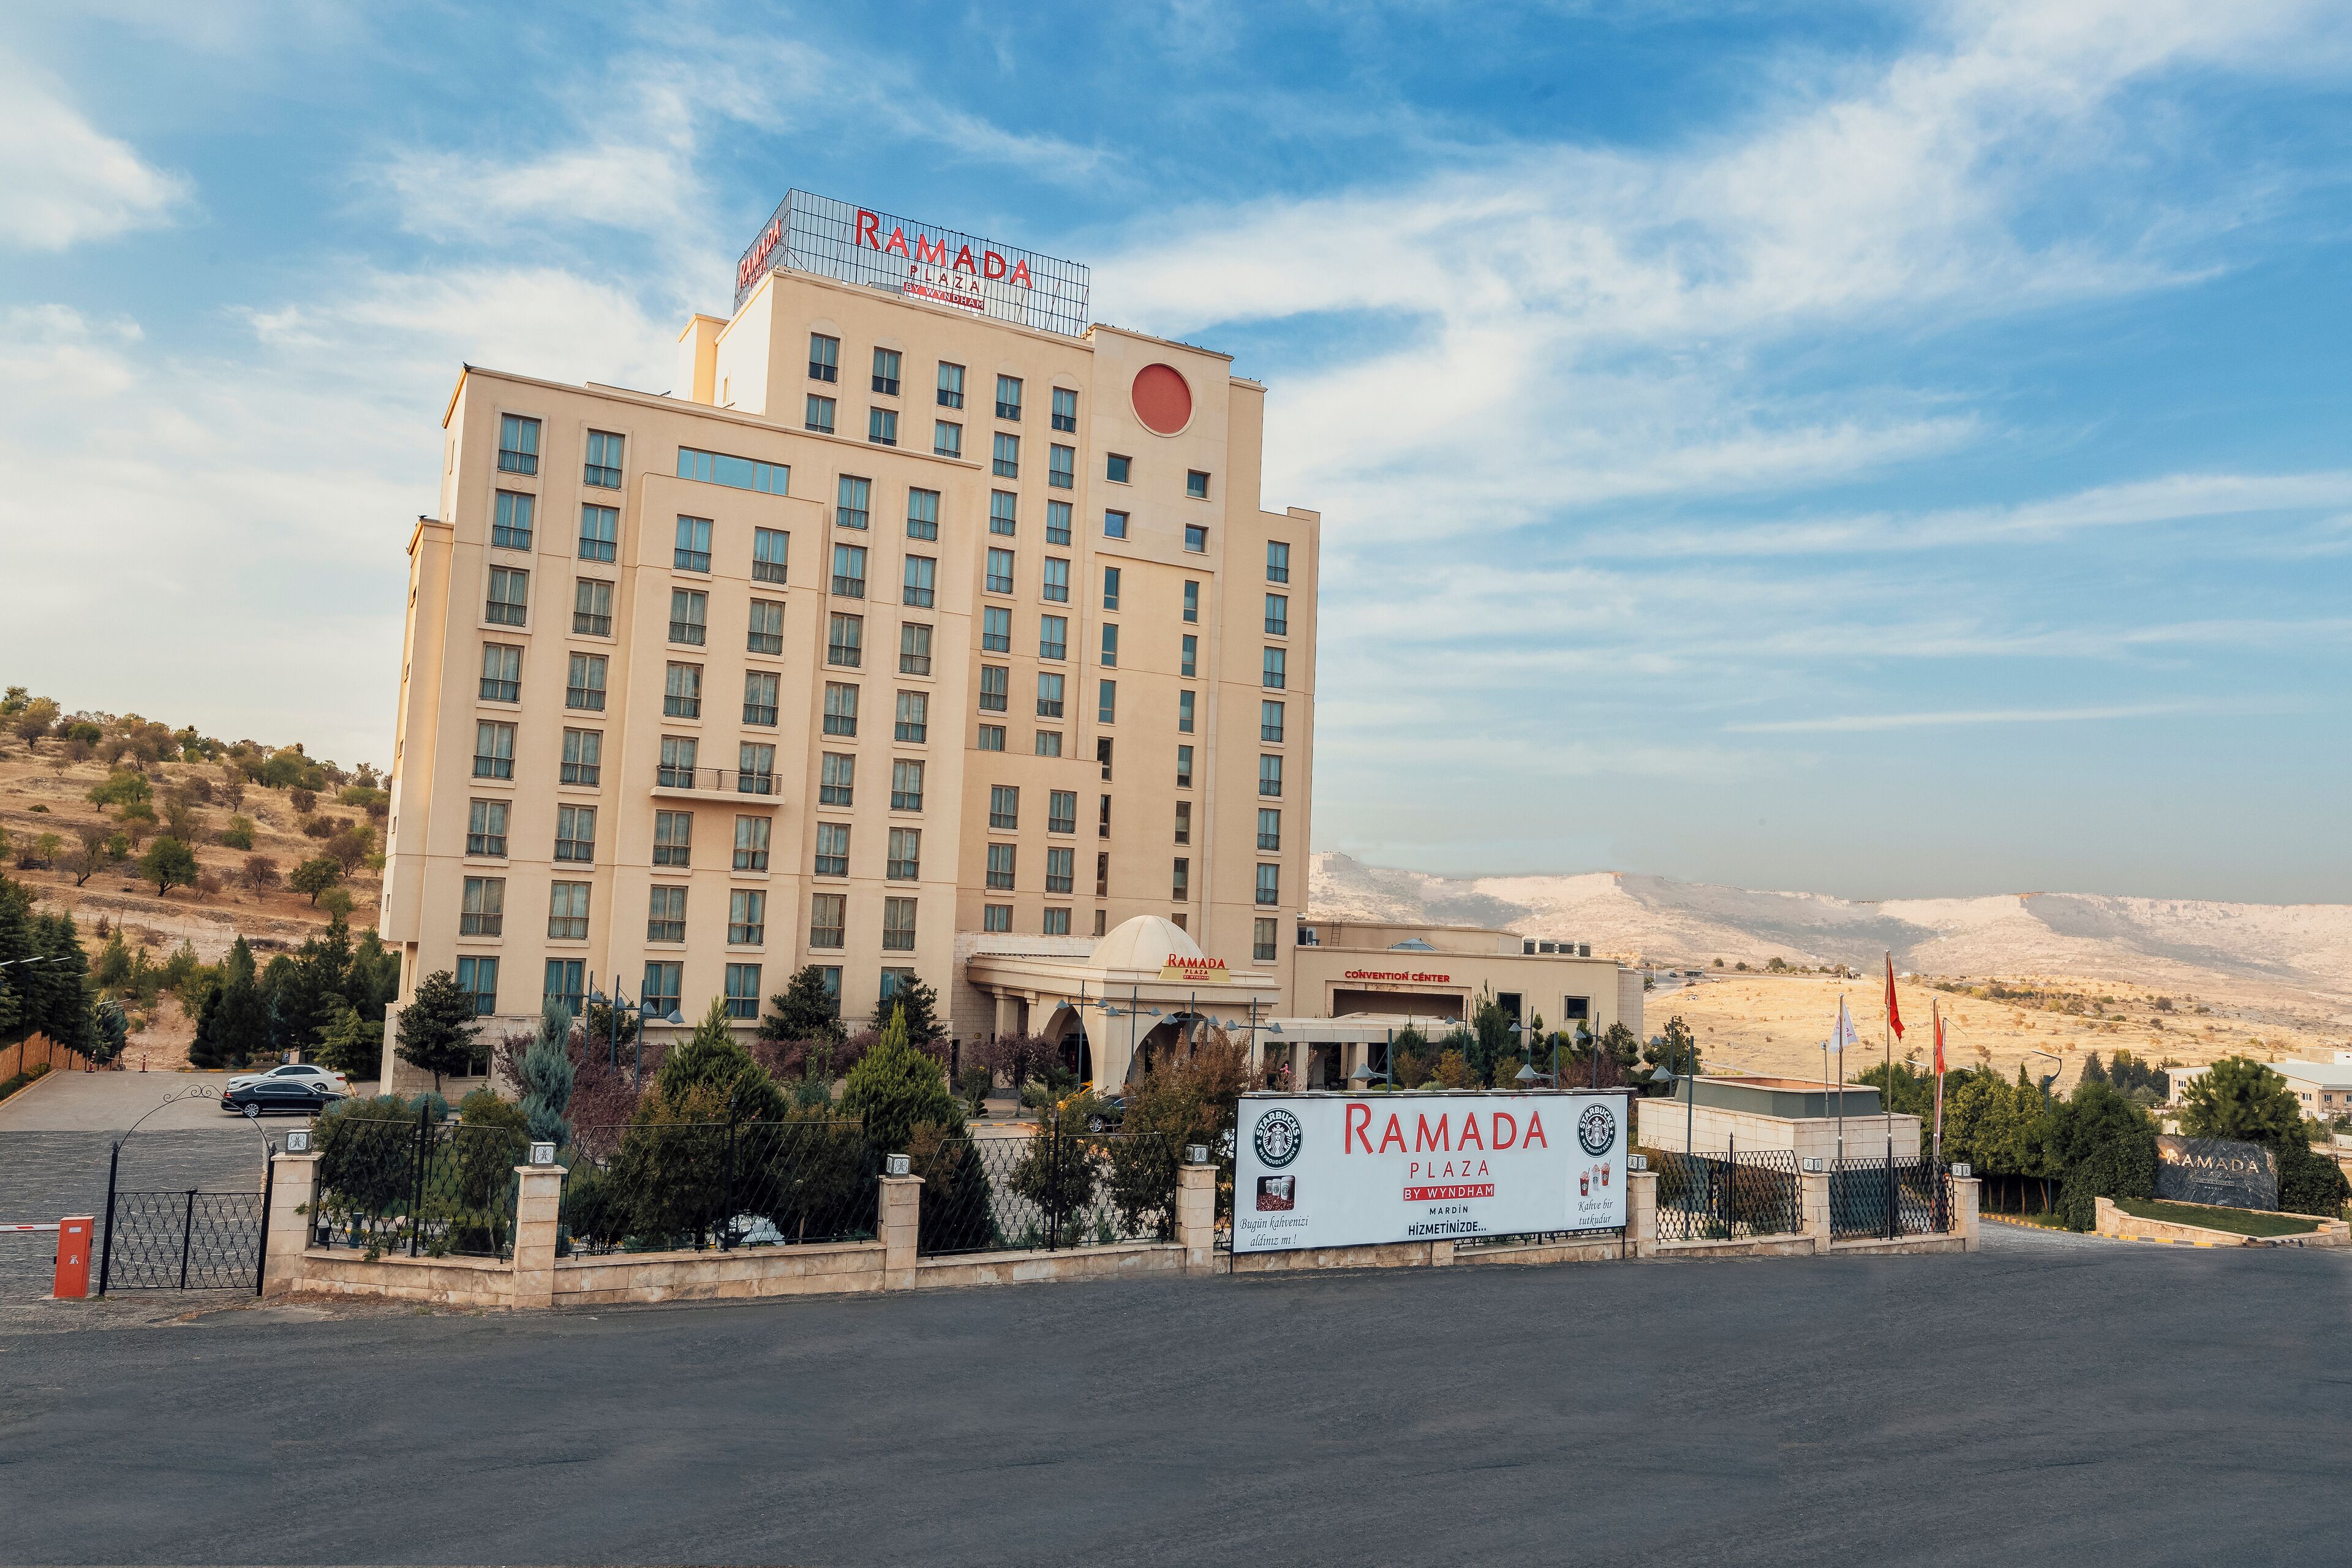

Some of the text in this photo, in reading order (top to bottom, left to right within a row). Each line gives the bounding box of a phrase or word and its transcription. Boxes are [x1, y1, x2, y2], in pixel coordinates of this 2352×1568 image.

[739, 219, 781, 289] RAMADA
[856, 209, 1033, 288] RAMADA
[910, 265, 979, 293] PLAZA
[906, 284, 984, 309] BY WYNDHAM
[1167, 953, 1226, 969] RAMADA
[1344, 970, 1450, 982] CONVENTION CENTER
[1256, 1111, 1300, 1137] STARBUCKS
[1580, 1106, 1614, 1129] STARBUCKS
[1344, 1102, 1548, 1155] RAMADA
[1602, 1137, 1612, 1150] SERVE
[1259, 1147, 1297, 1164] WE PROUDLY SERVE
[2166, 1148, 2260, 1174] RAMADA
[1410, 1159, 1489, 1179] PLAZA
[2195, 1169, 2231, 1180] PLAZA
[1404, 1185, 1493, 1199] BY WYNDHAM
[1430, 1204, 1468, 1215] MARDİN
[1578, 1198, 1613, 1213] Kahve bir
[1239, 1215, 1309, 1232] Bugün kahvenizi
[1408, 1219, 1487, 1236] HİZMETİNİZDE...
[1579, 1213, 1611, 1227] tutkudur
[1250, 1234, 1279, 1246] aldınız
